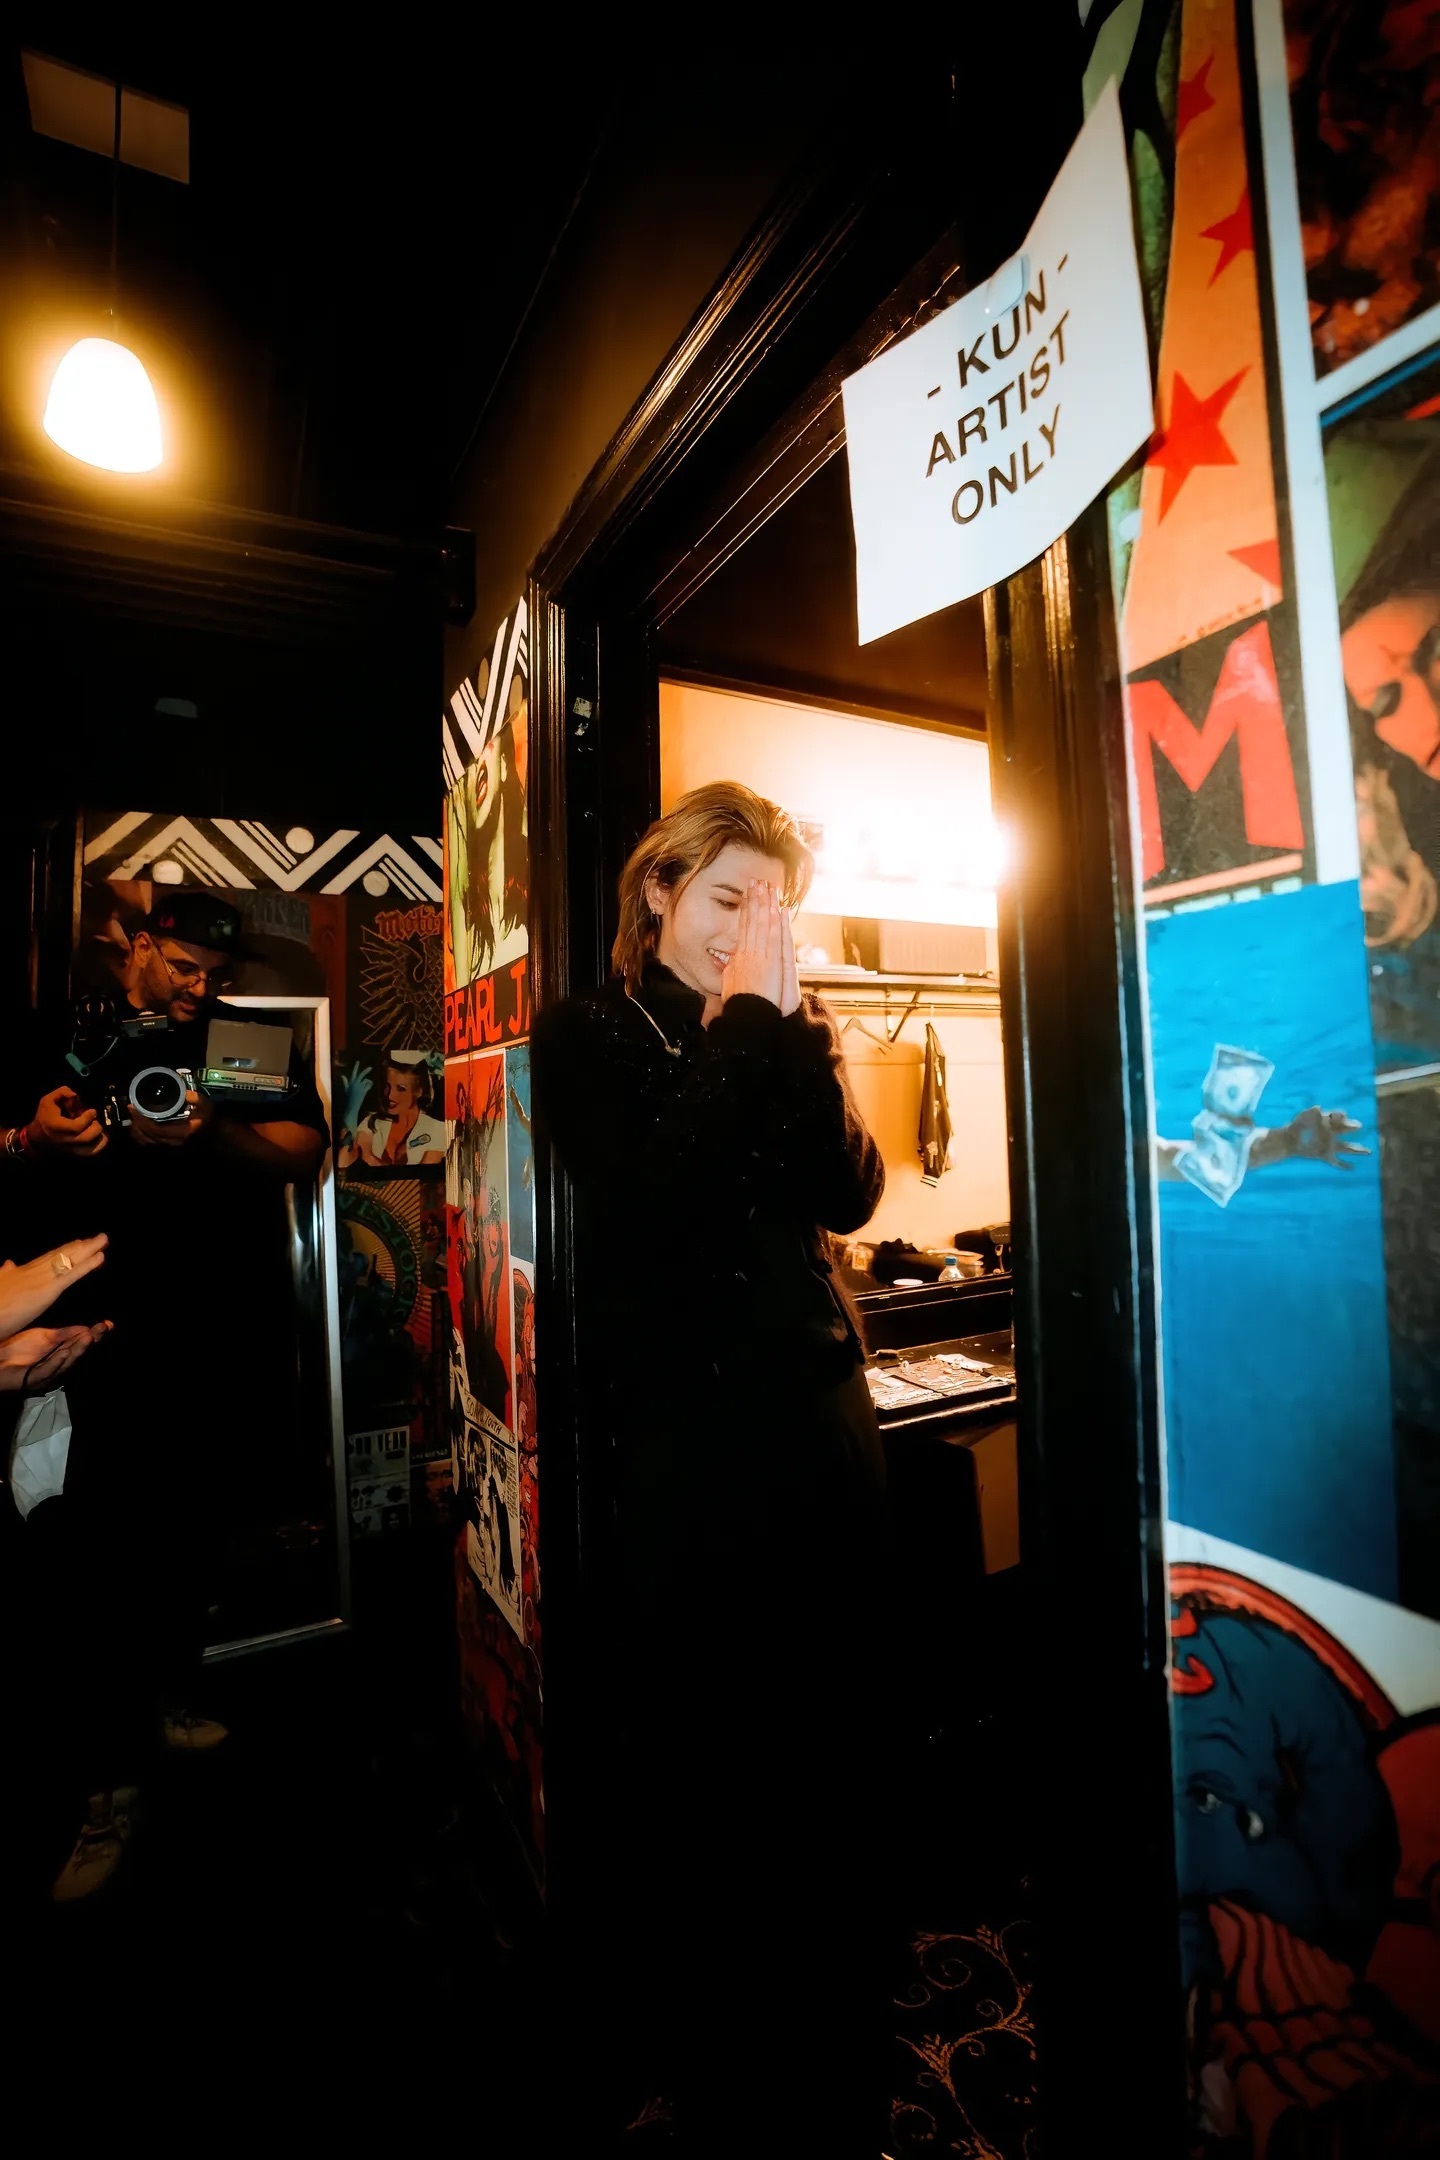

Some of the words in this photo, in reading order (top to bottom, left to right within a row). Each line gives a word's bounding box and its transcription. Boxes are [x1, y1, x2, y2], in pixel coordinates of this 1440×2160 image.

[957, 267, 1049, 389] KUN
[925, 309, 1070, 479] ARTIST
[950, 403, 1061, 526] ONLY
[443, 975, 503, 1056] PEARL
